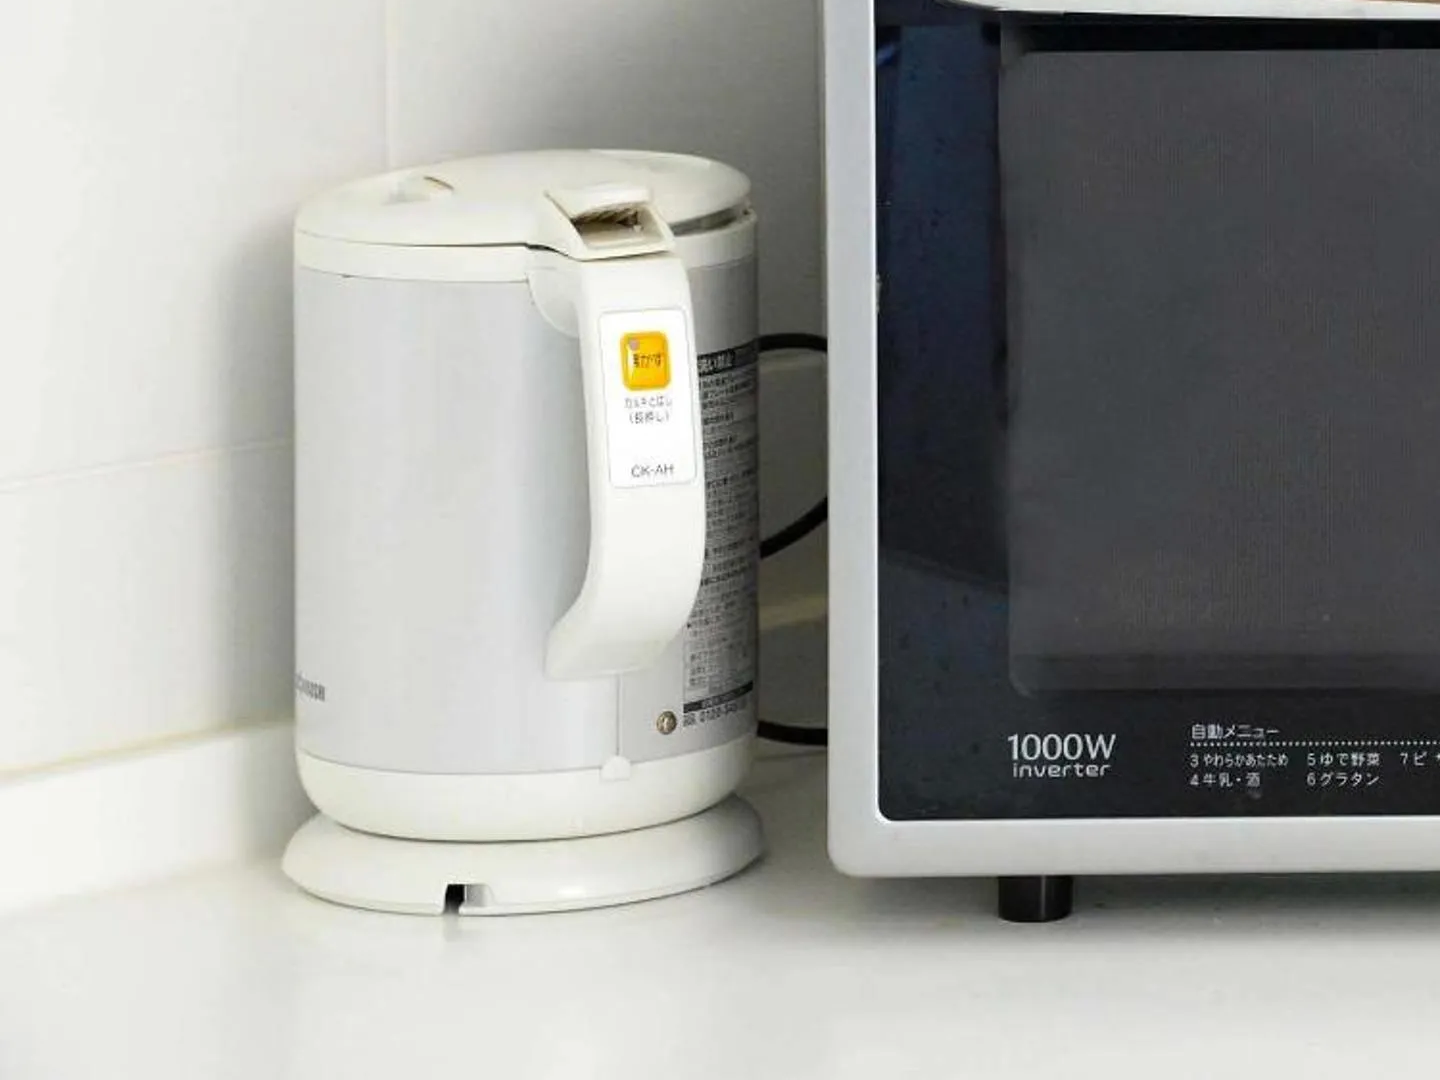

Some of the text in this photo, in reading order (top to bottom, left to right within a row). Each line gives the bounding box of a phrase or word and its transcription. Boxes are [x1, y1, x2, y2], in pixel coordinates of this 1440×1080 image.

[631, 463, 674, 478] CK-AH
[1191, 724, 1280, 739] 自動メニュー
[1007, 733, 1116, 760] 1000W
[1190, 752, 1290, 767] 3 やわらかあたため
[1307, 752, 1381, 767] 5 ゆで野菜
[1400, 752, 1409, 765] 7
[1013, 762, 1111, 778] inverter
[1190, 774, 1200, 787] 4
[1307, 772, 1380, 787] 6 グラタン
